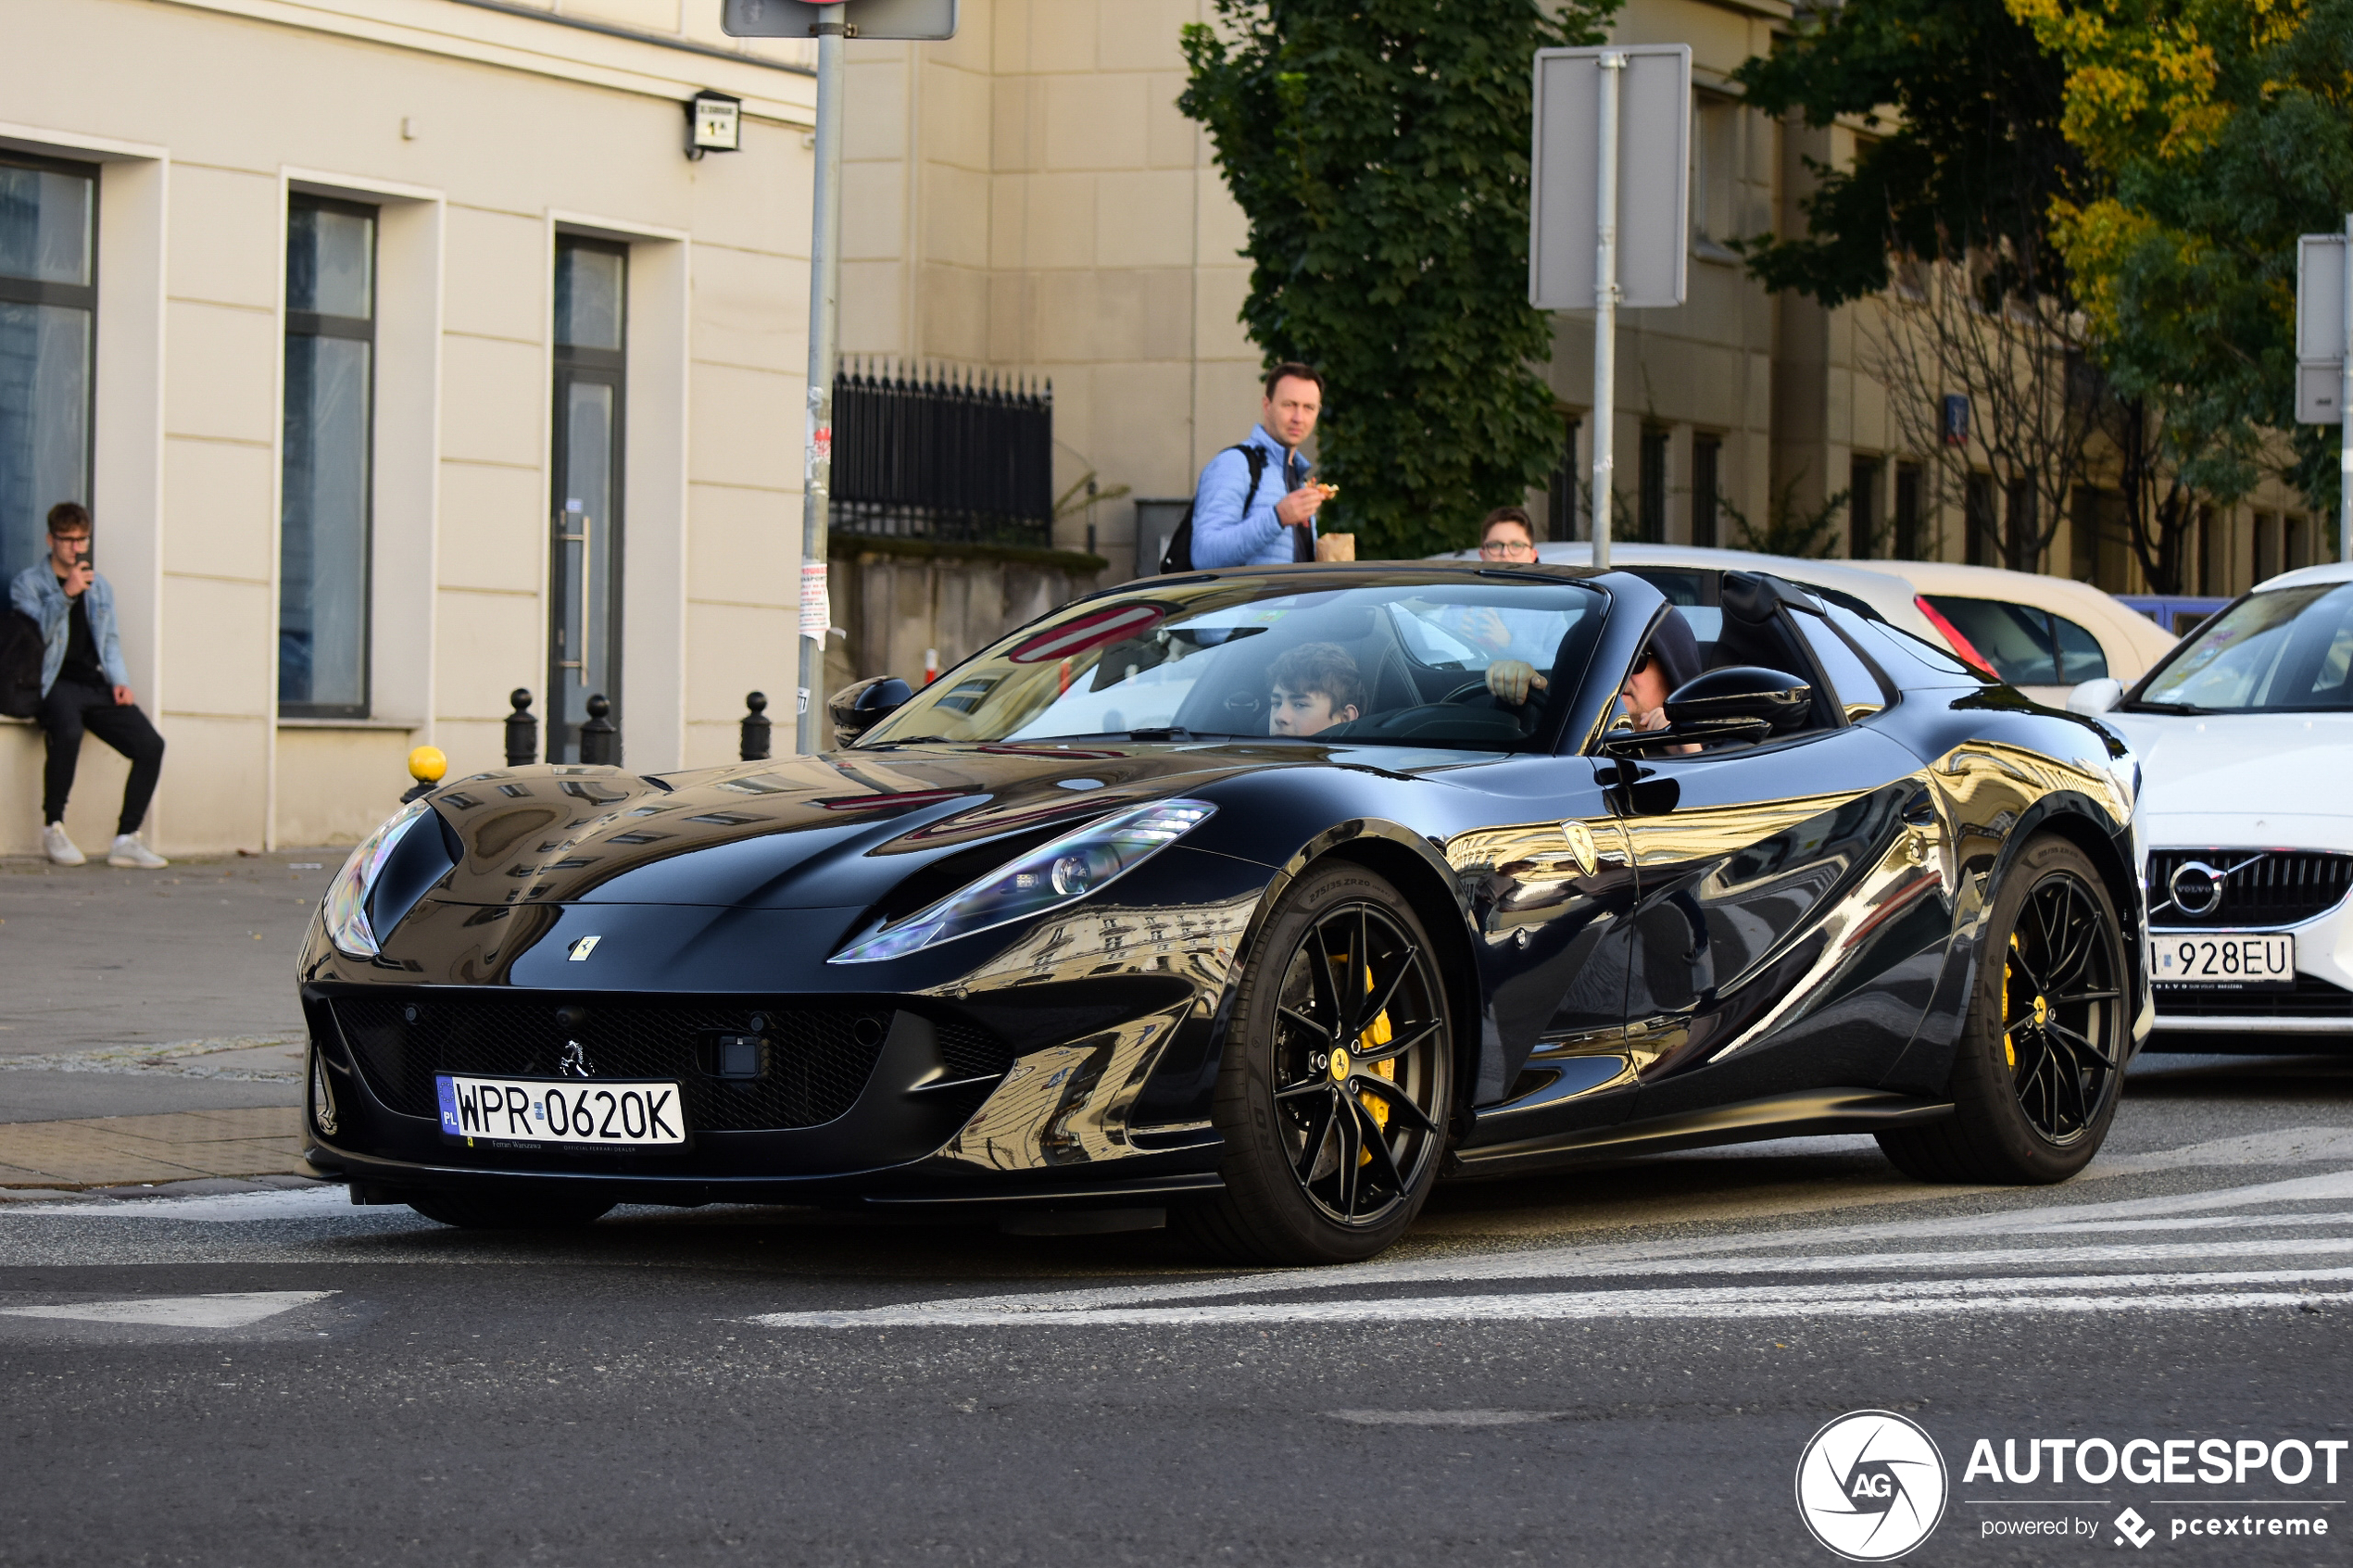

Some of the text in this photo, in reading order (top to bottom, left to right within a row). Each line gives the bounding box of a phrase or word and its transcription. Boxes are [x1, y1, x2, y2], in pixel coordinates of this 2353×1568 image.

[1309, 878, 1370, 903] 275/35 ZR20
[2175, 884, 2212, 894] VOLVO
[2179, 941, 2285, 974] 928EU
[443, 1111, 458, 1125] PL
[456, 1083, 679, 1139] WPR 0620K
[512, 1141, 542, 1149] Warszawa
